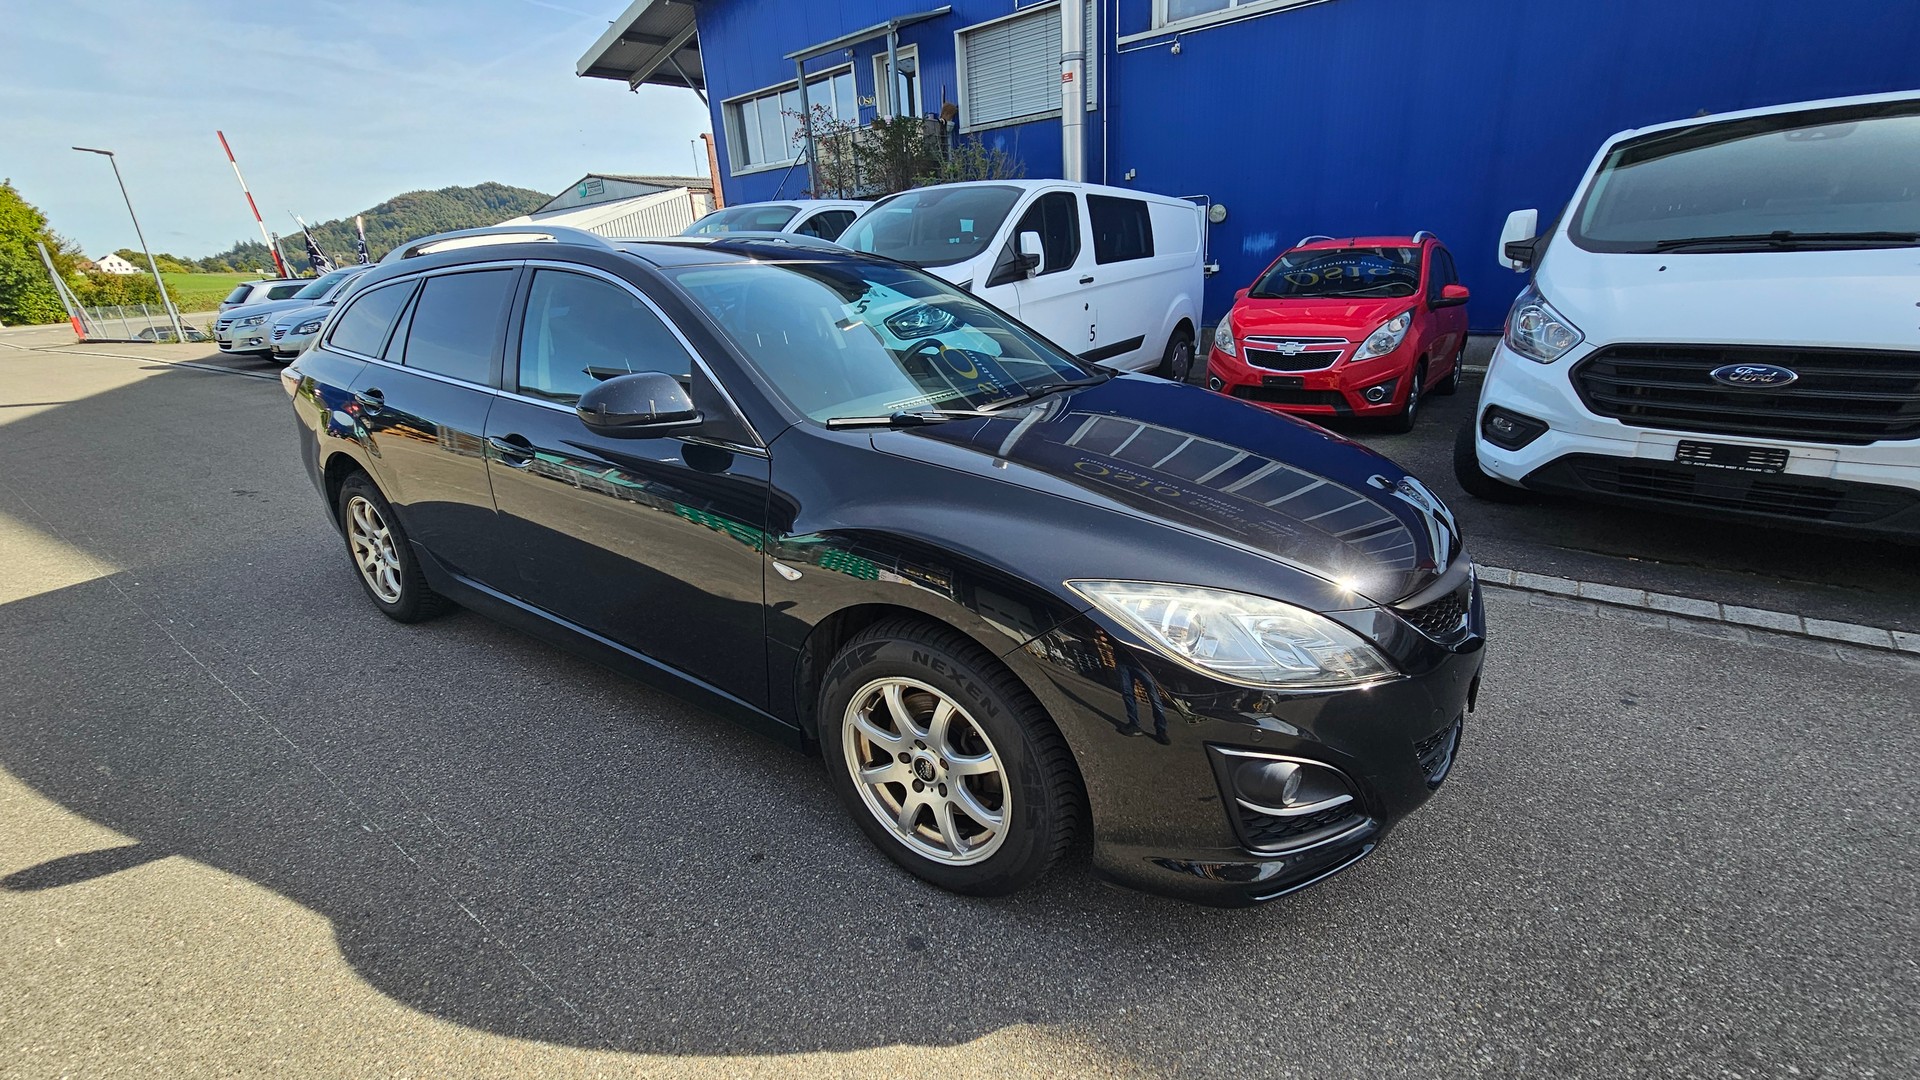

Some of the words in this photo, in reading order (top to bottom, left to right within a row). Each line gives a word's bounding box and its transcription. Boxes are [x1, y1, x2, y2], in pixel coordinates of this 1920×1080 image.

[854, 300, 871, 315] 5
[1089, 324, 1096, 342] 5
[1728, 366, 1778, 383] Ford
[911, 649, 1001, 718] NEXEN
